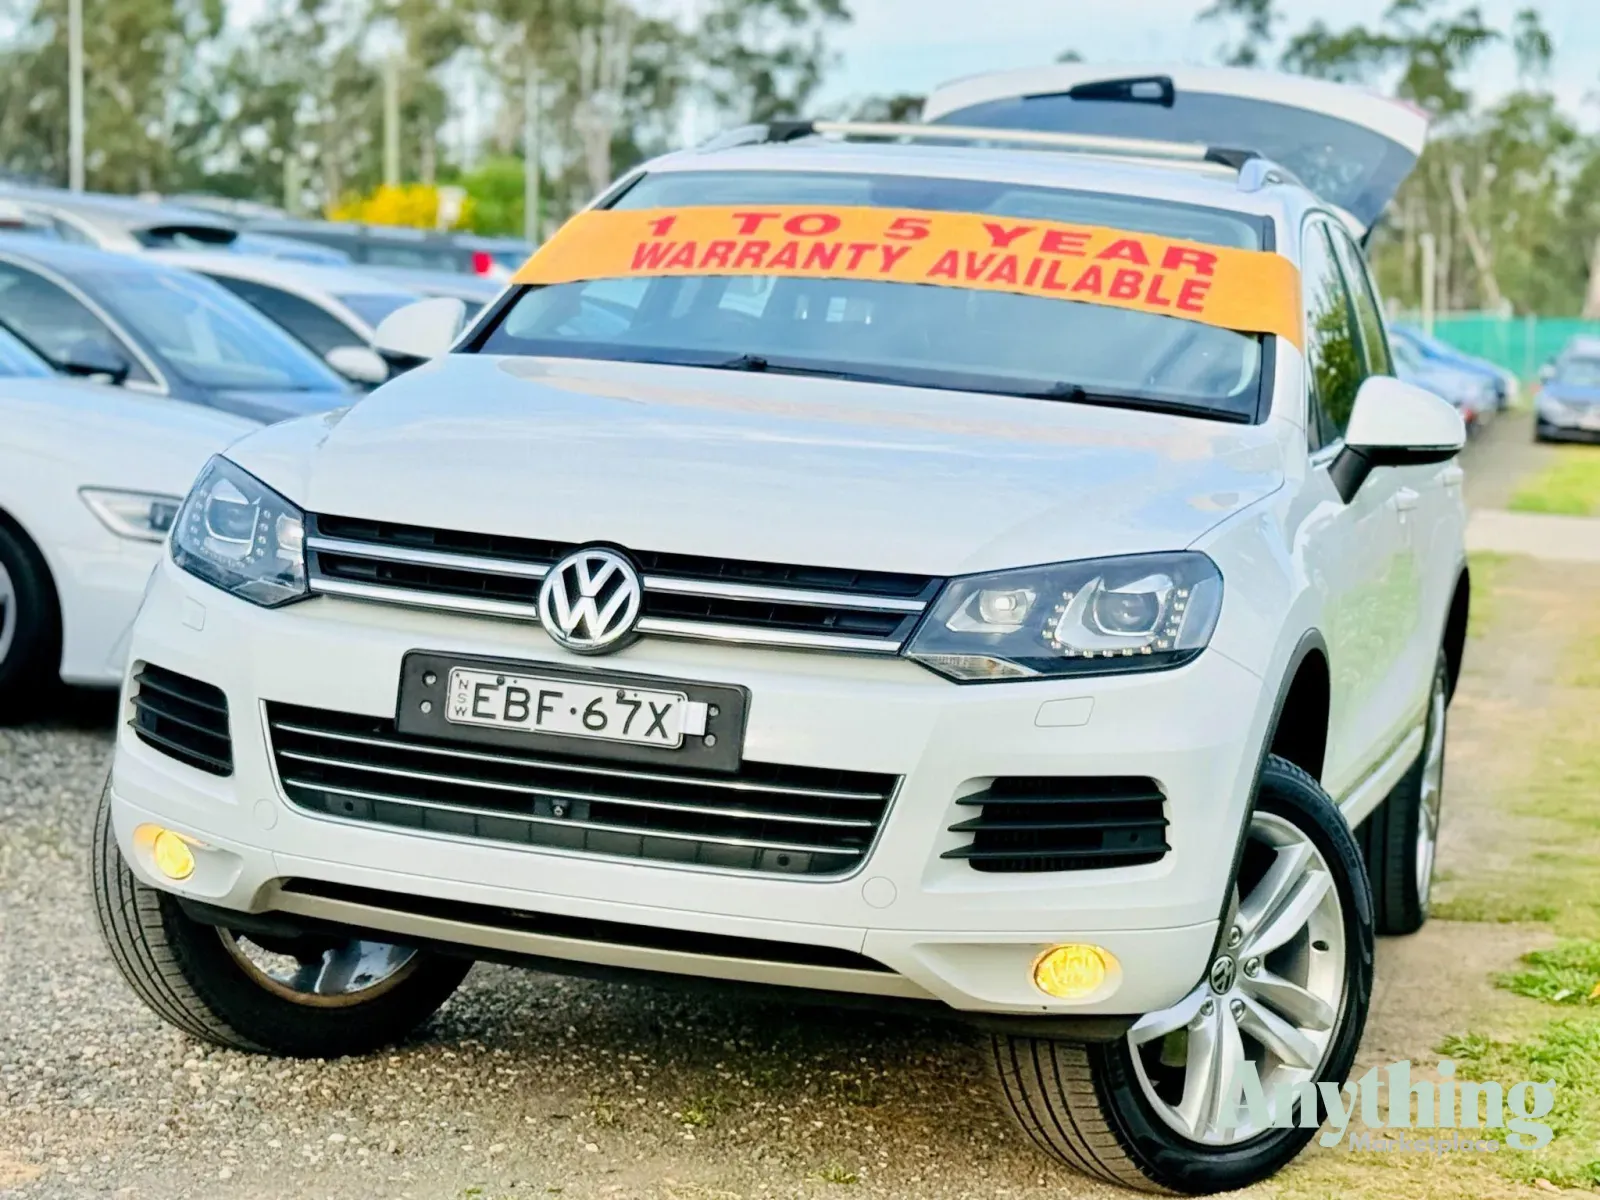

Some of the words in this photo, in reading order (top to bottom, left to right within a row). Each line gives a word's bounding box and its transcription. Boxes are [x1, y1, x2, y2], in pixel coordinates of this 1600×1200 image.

[630, 240, 912, 273] WARRANTY
[926, 249, 1212, 313] AVAILABLE
[647, 215, 678, 237] 1
[731, 213, 842, 236] TO
[883, 217, 932, 240] 5
[982, 222, 1219, 277] YEAR
